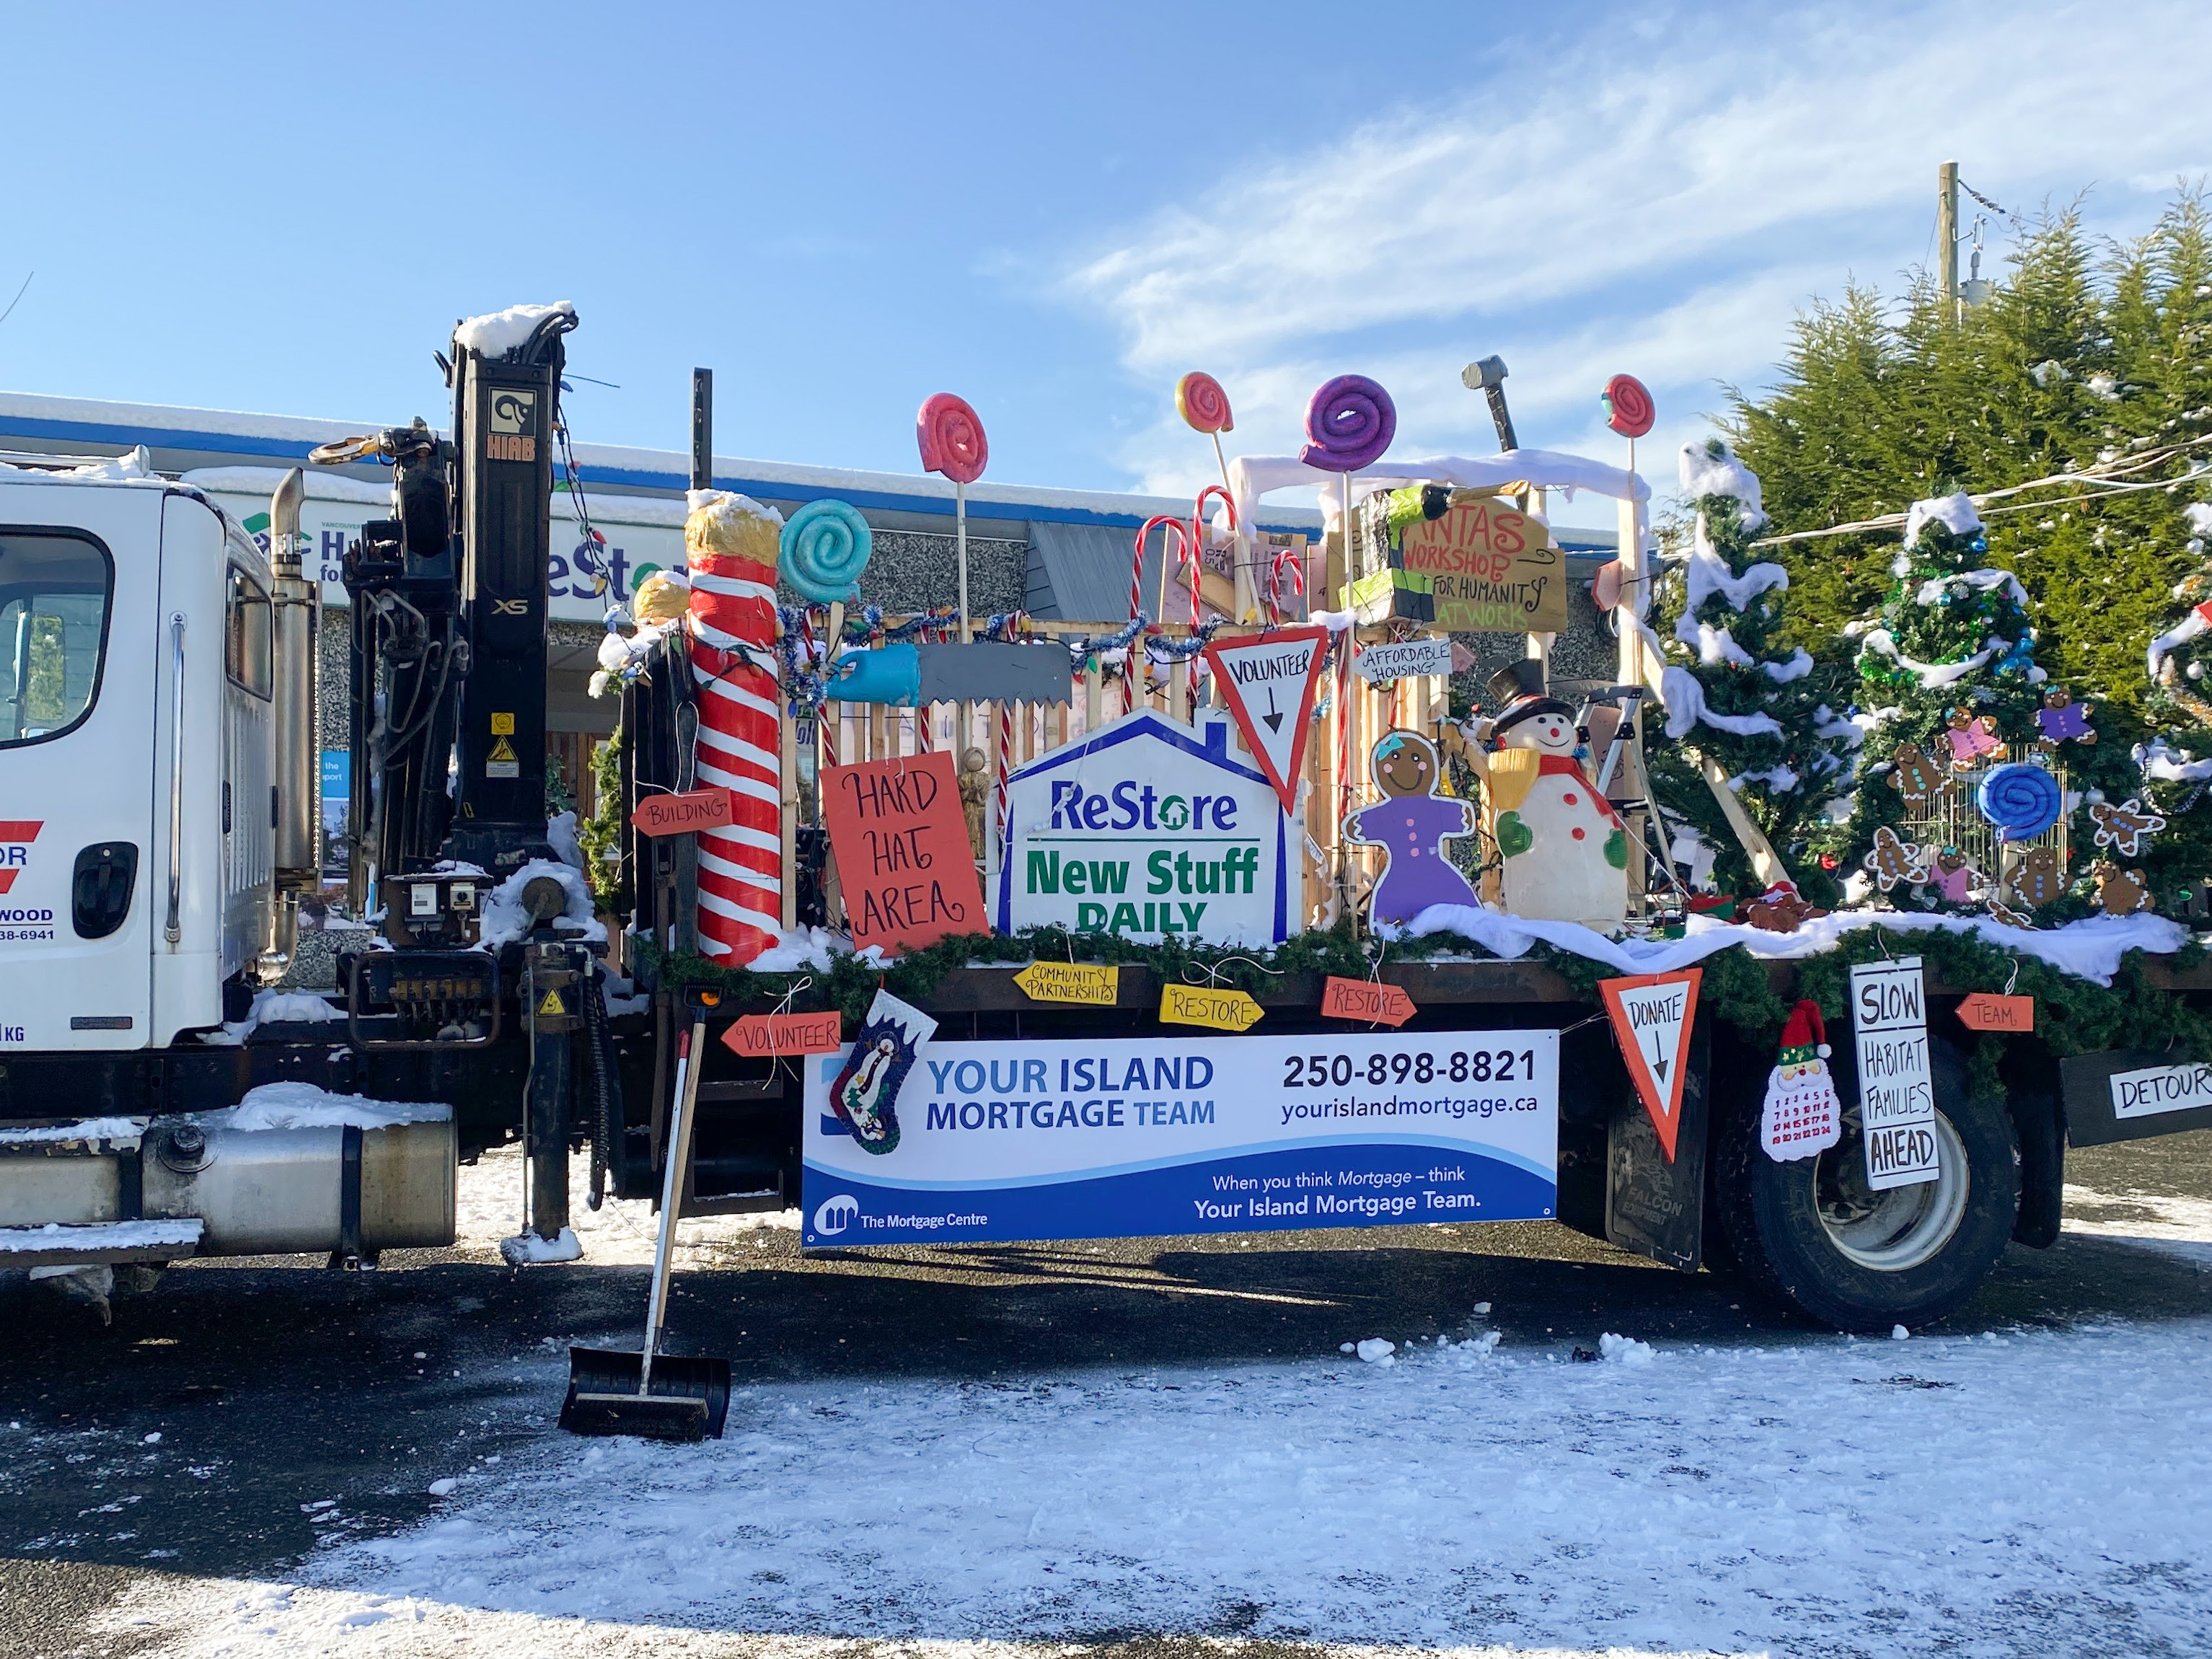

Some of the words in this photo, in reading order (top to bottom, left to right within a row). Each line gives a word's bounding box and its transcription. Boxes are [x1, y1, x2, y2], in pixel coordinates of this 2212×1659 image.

[487, 434, 535, 462] HIAB
[1404, 541, 1511, 583] WORKSHOP
[491, 599, 528, 615] XS
[1433, 576, 1455, 597] FOR
[1459, 576, 1547, 612] HUMANITY
[1435, 602, 1464, 625] AT
[1464, 603, 1528, 630] WORK
[1230, 649, 1310, 685] VOLUNTEER
[1362, 642, 1450, 668] AFFORDABLE
[1372, 661, 1436, 681] HOUSING
[645, 798, 728, 825] BUILDING
[842, 770, 938, 818] HARD
[1052, 780, 1238, 831] ReStore
[863, 826, 933, 876] HAT
[1027, 850, 1130, 894] New
[1147, 848, 1259, 894] Stuff
[855, 879, 964, 936] AREA
[1077, 902, 1208, 933] DAILY
[1026, 980, 1116, 1001] PARTNERSHIPS
[1031, 964, 1107, 985] COMMUNITY
[1169, 988, 1256, 1025] RESTORE
[1332, 983, 1407, 1016] RESTORE
[1628, 993, 1683, 1029] DONATE
[1861, 977, 1919, 1025] SLOW
[1971, 999, 2017, 1026] TEAM
[927, 1059, 1047, 1094] YOUR
[1060, 1056, 1214, 1092] ISLAND
[1283, 1049, 1534, 1088] 250-898-8821
[1864, 1037, 1926, 1078] HABITAT
[1866, 1082, 1931, 1119] FAMILIES
[2120, 1068, 2212, 1109] DETOUR
[926, 1099, 1124, 1130] MORTGAGE
[1133, 1100, 1215, 1126] TEAM
[1282, 1095, 1538, 1125] yourislandmortgage.ca
[1872, 1129, 1934, 1174] AHEAD
[1212, 1174, 1259, 1191] When
[1262, 1177, 1291, 1193] you
[1295, 1171, 1333, 1187] think
[1338, 1170, 1411, 1188] Mortgage
[1429, 1166, 1466, 1182] think
[860, 1215, 884, 1228] The
[887, 1215, 945, 1230] Mortgage
[946, 1213, 988, 1226] Centre
[1194, 1200, 1243, 1219] Your
[1249, 1194, 1308, 1217] Island
[1316, 1194, 1416, 1217] Mortgage
[1422, 1190, 1481, 1209] Team.
